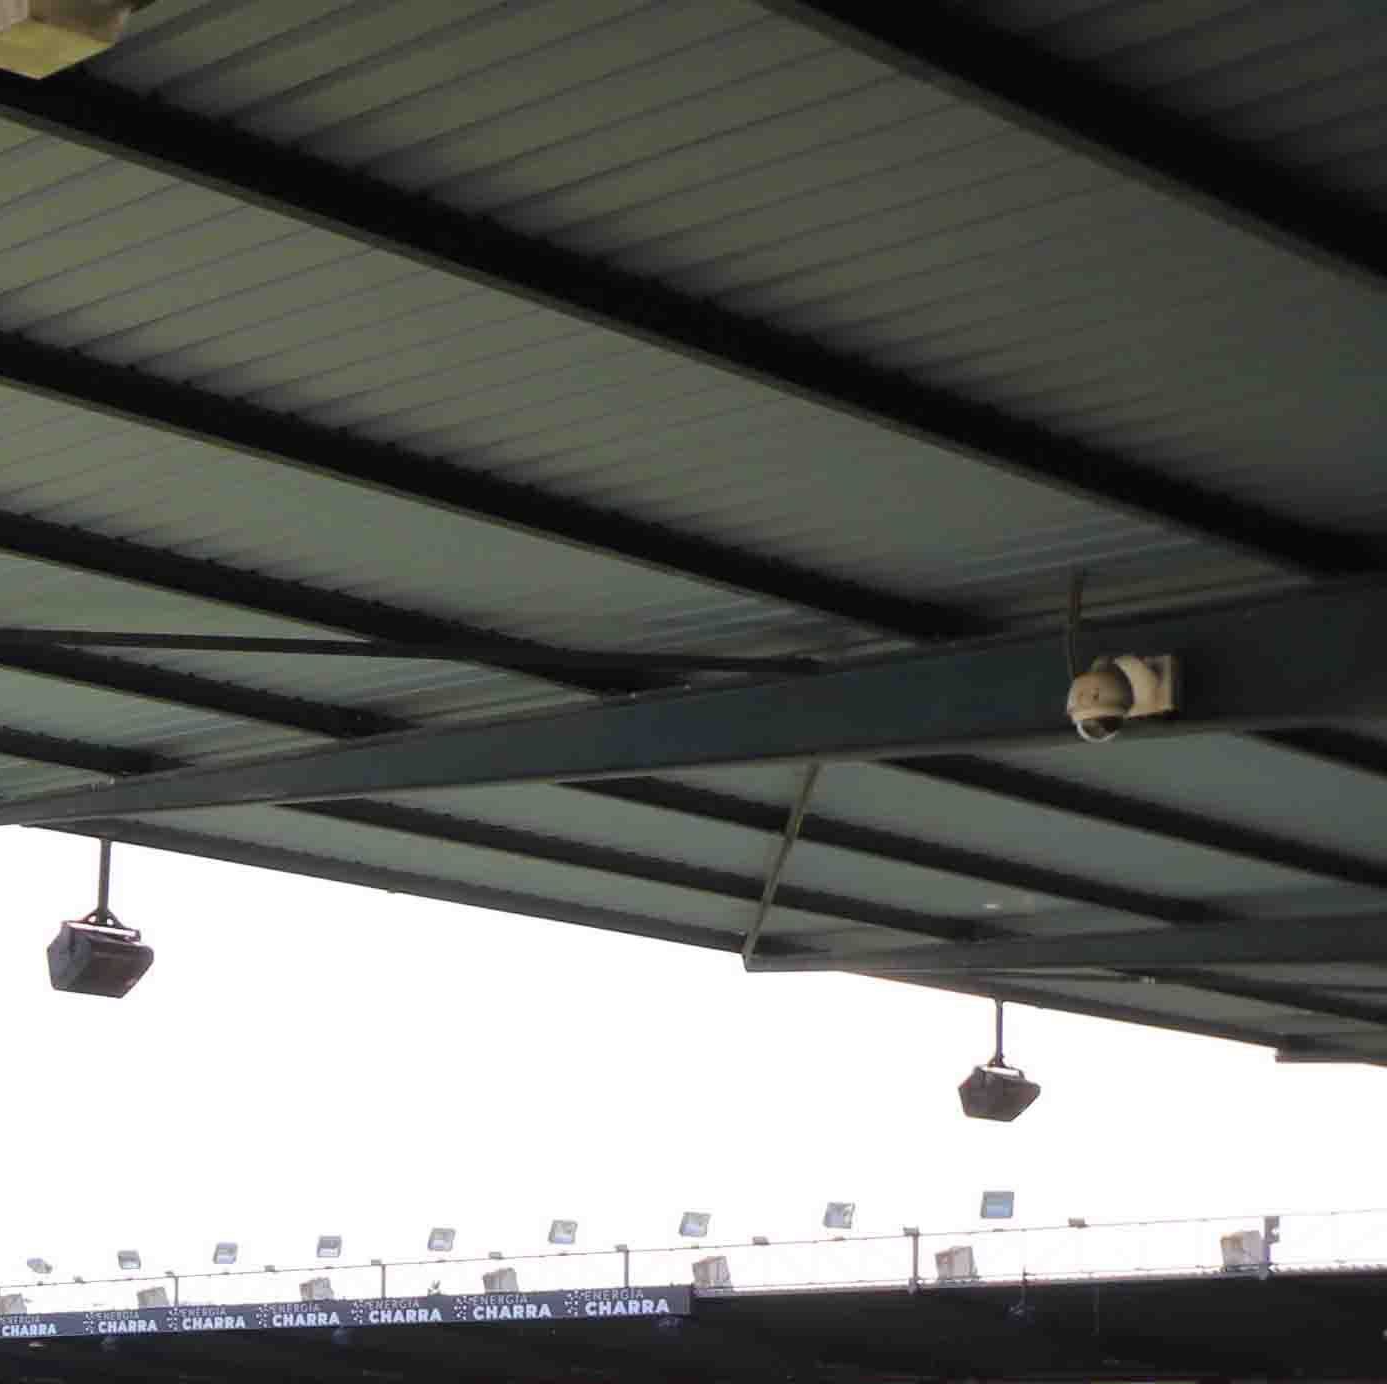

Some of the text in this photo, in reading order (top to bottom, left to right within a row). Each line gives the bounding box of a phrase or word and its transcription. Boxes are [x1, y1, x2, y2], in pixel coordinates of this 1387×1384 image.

[473, 1304, 552, 1320] CHARRA
[584, 1298, 670, 1315] CHARRA
[182, 1316, 246, 1330] CHARRA
[272, 1312, 340, 1327] CHARRA
[368, 1309, 442, 1323] CHARRA
[2, 1323, 57, 1336] CHARRA
[97, 1320, 157, 1333] CHARRA
